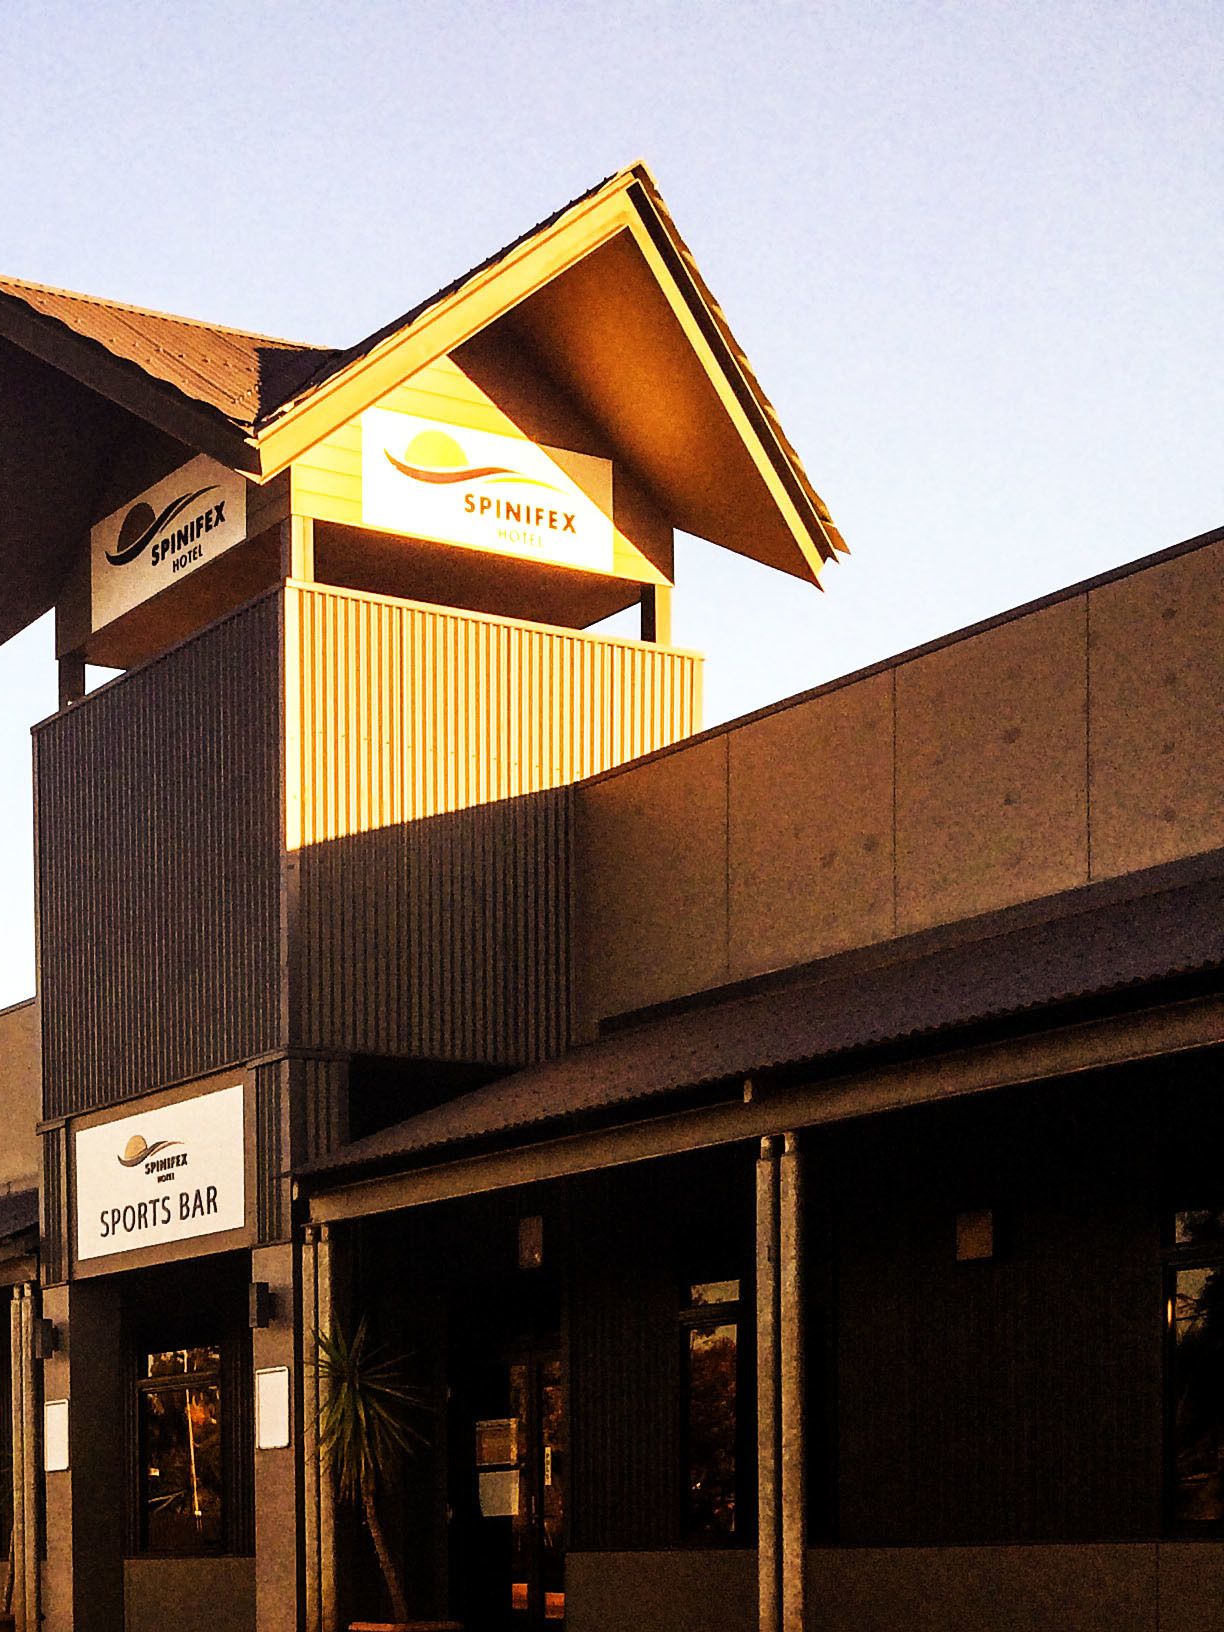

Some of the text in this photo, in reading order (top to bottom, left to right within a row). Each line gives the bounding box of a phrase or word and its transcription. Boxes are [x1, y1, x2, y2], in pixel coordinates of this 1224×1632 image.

[464, 493, 576, 534] SPINIFEX
[152, 500, 225, 566] SPINIFEX
[498, 528, 543, 548] HOTEL
[172, 544, 203, 573] HOTEL
[144, 1153, 188, 1175] SPINIFEX
[100, 1185, 218, 1238] SPORTS BAR
